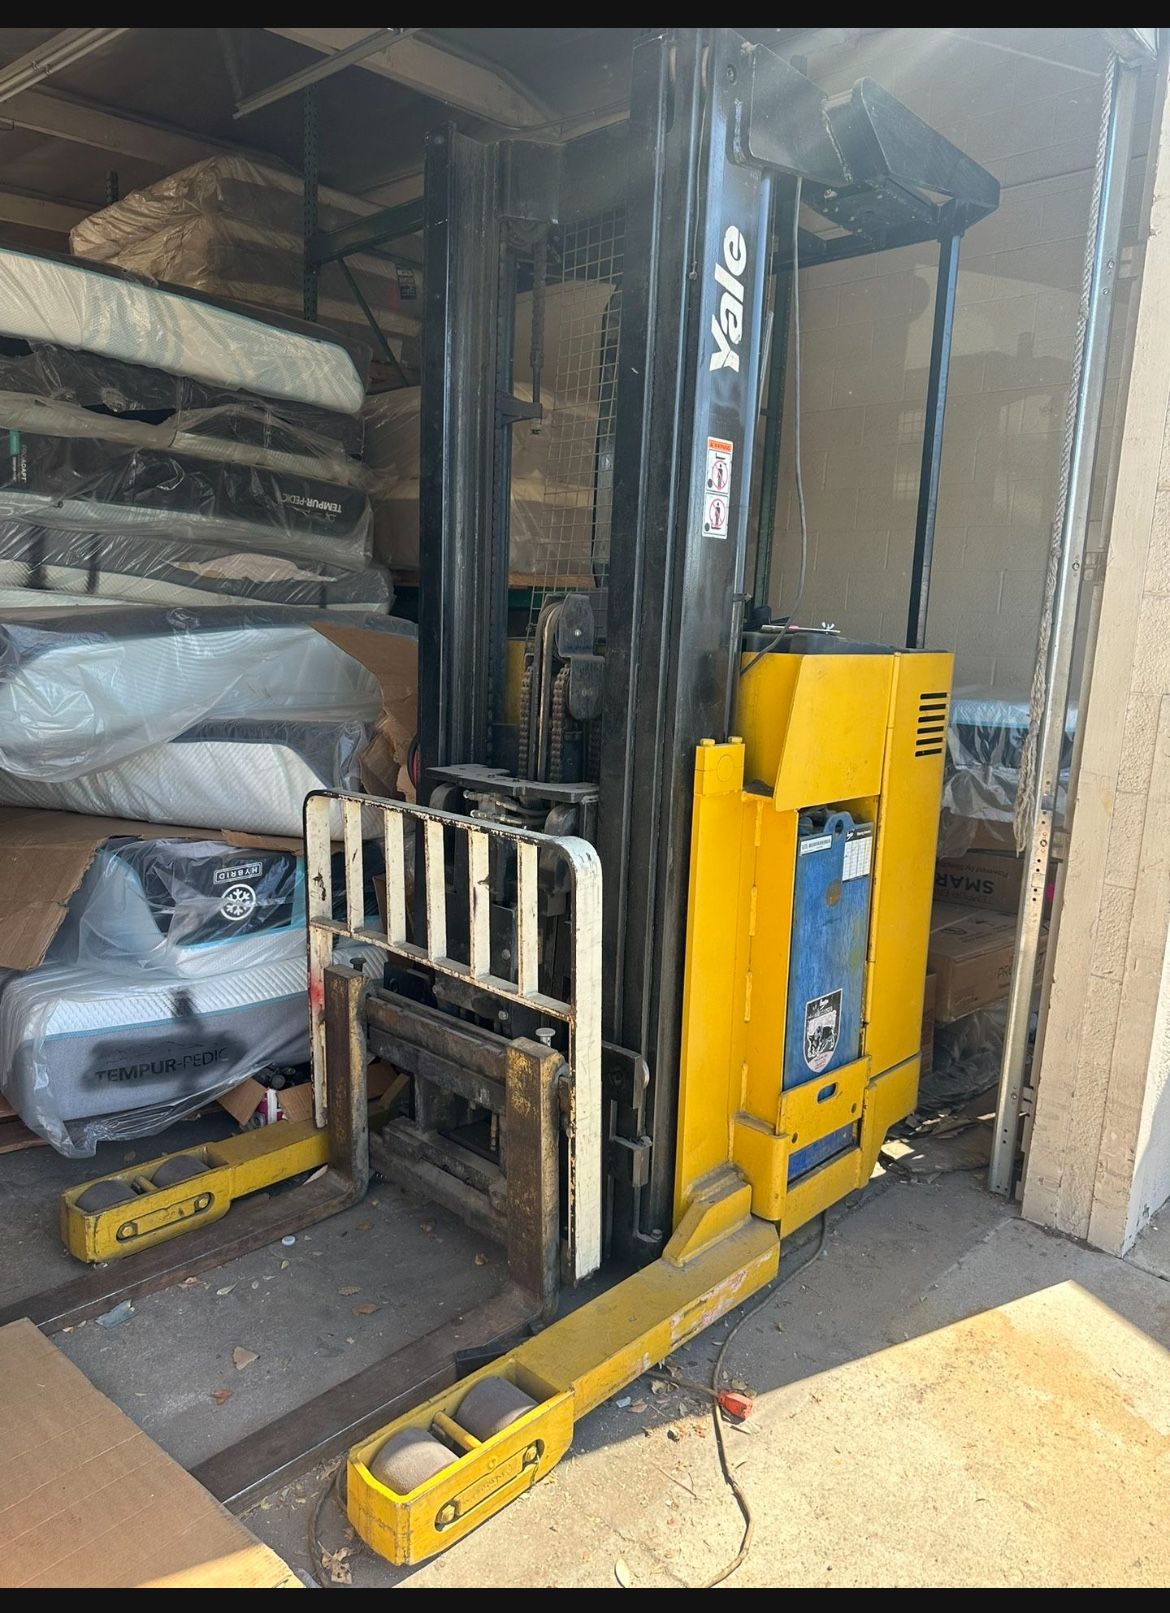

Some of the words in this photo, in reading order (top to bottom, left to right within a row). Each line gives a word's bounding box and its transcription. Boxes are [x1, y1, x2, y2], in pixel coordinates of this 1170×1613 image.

[709, 226, 747, 372] Yale
[281, 493, 342, 513] TEMPUR-PEDIC
[219, 867, 258, 879] HYBRID
[95, 1047, 227, 1082] TEMPUR-PEDIC
